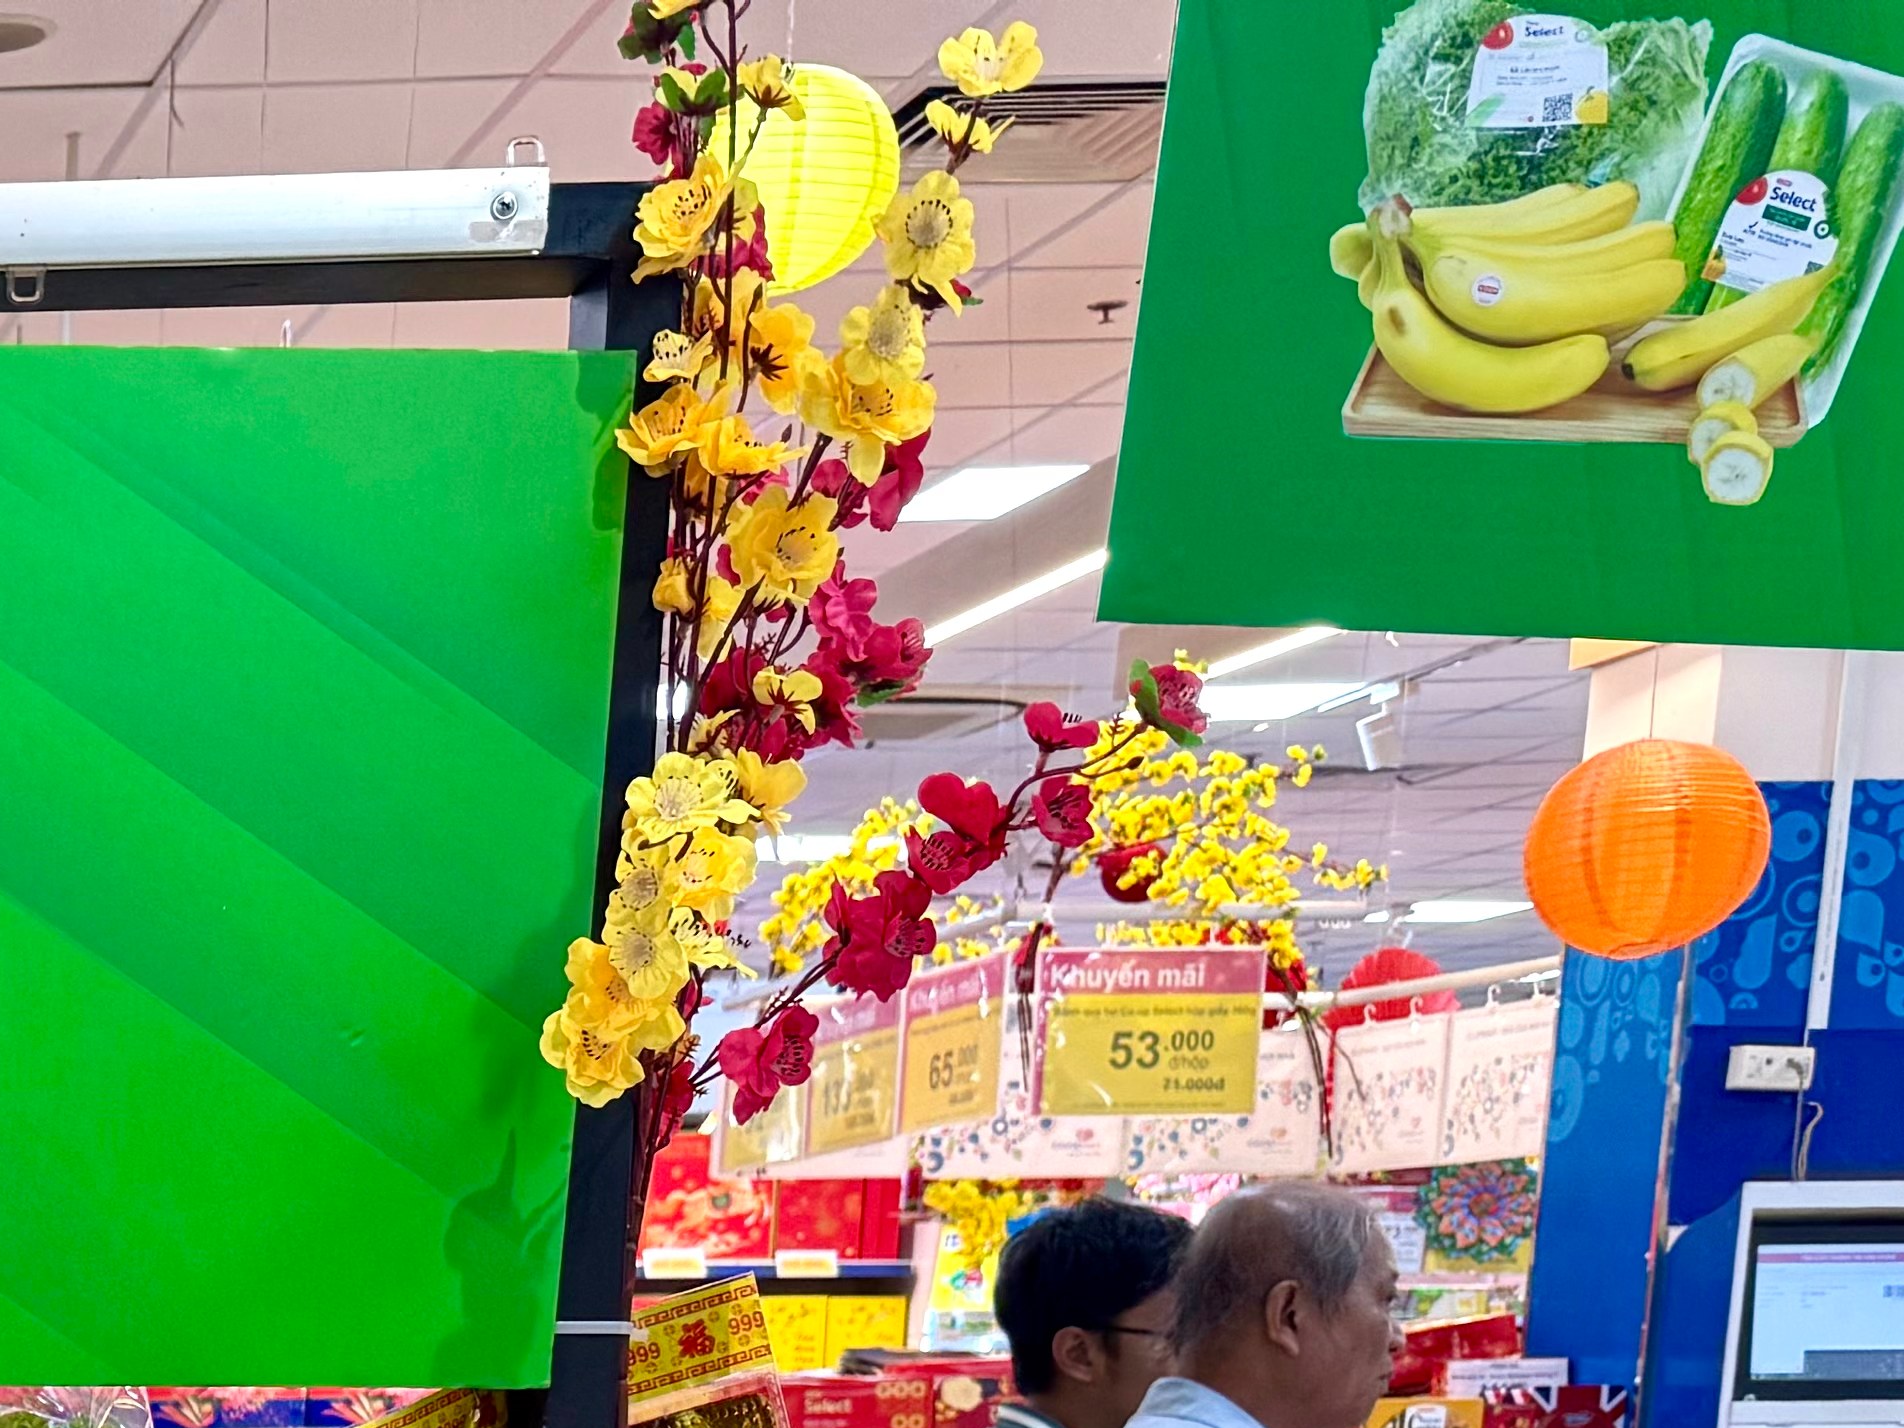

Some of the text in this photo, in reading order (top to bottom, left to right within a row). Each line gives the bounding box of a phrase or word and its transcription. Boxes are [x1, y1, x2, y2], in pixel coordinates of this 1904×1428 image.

[1770, 187, 1817, 212] Select
[1050, 959, 1206, 992] Khuyến mãi
[678, 1319, 715, 1358] 福
